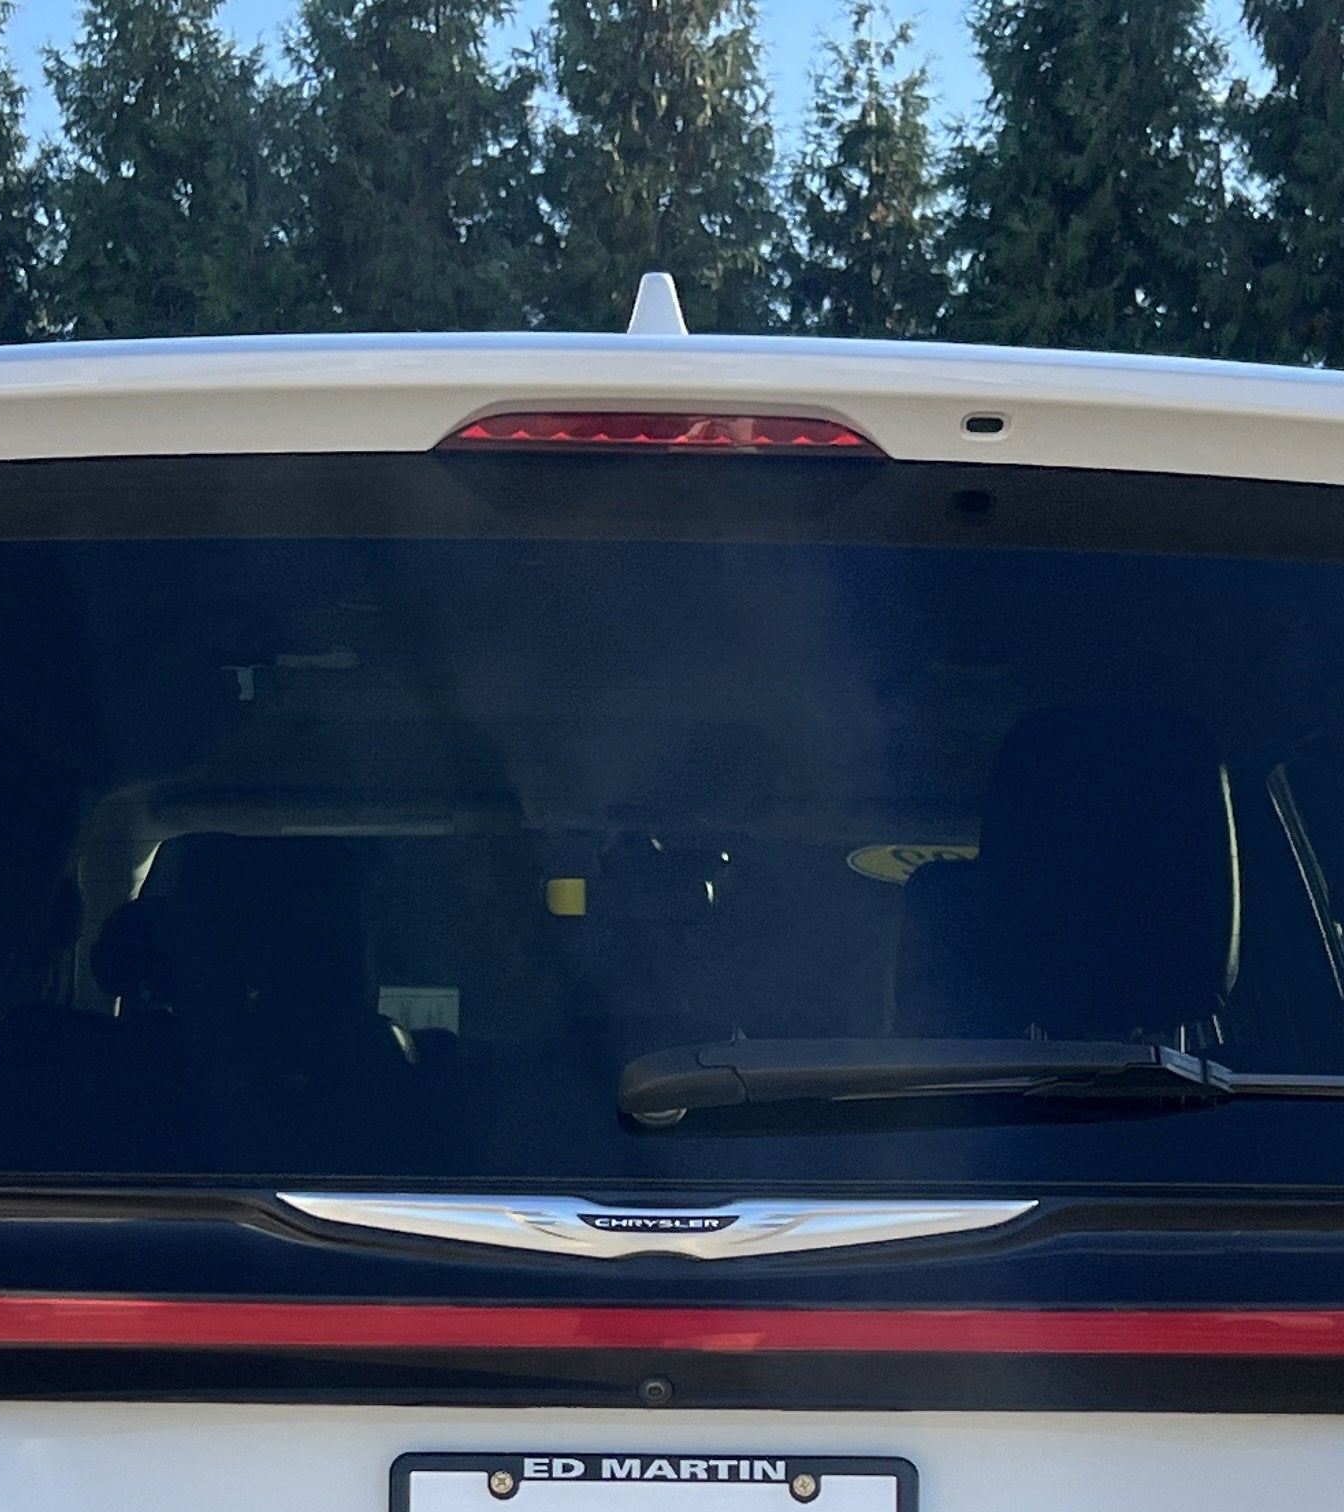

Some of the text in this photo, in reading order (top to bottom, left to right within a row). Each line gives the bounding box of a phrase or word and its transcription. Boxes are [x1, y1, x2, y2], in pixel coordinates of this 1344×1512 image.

[594, 1217, 720, 1229] CHRYSLER
[523, 1457, 787, 1482] ED MARTIN
